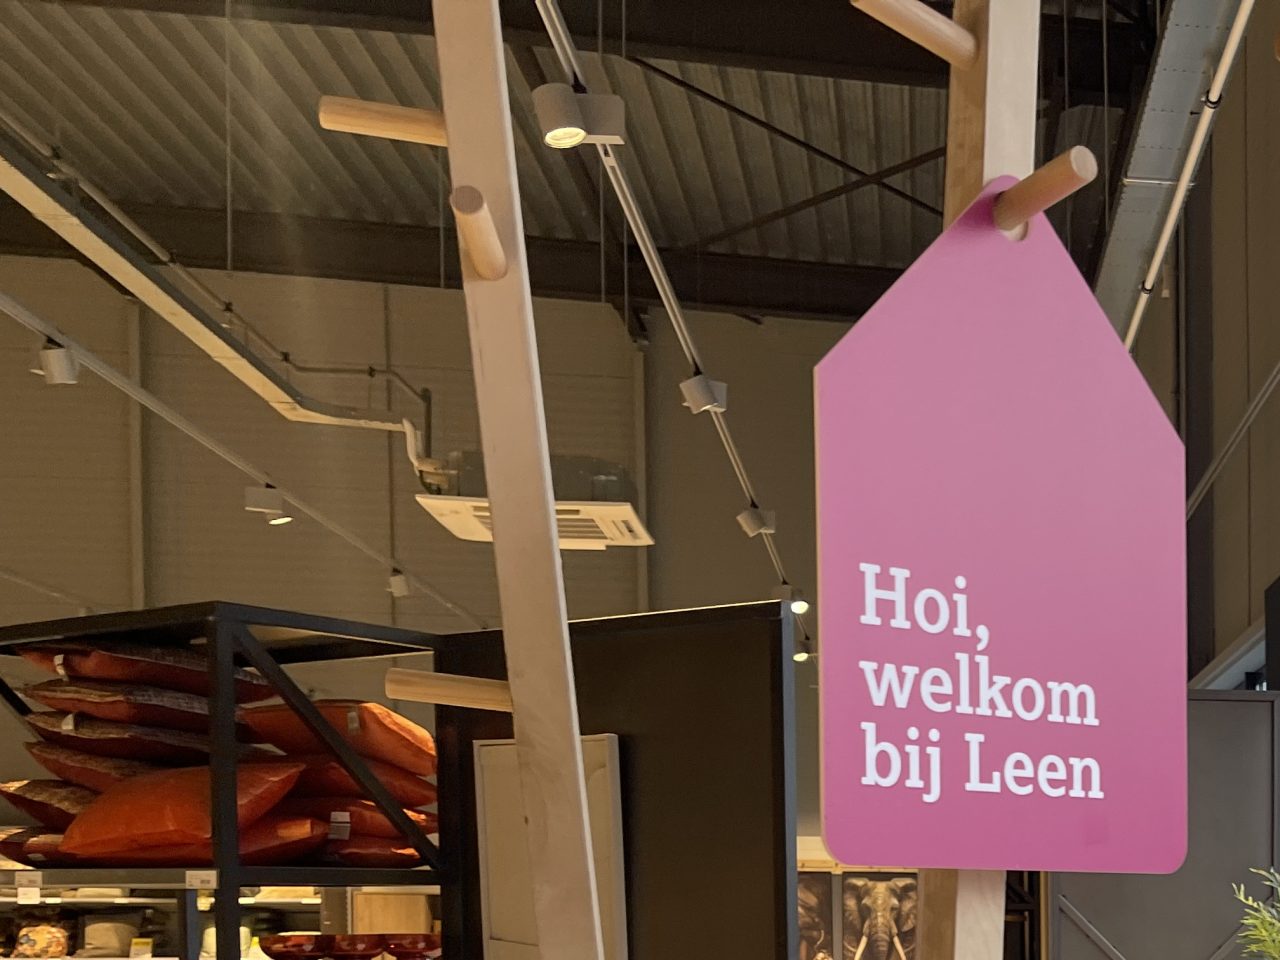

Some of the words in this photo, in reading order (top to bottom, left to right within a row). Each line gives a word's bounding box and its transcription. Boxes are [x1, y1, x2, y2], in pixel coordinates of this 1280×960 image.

[859, 562, 990, 651] Hoi,
[859, 652, 1100, 726] welkom
[860, 722, 941, 803] bij
[964, 732, 1104, 799] Leen
